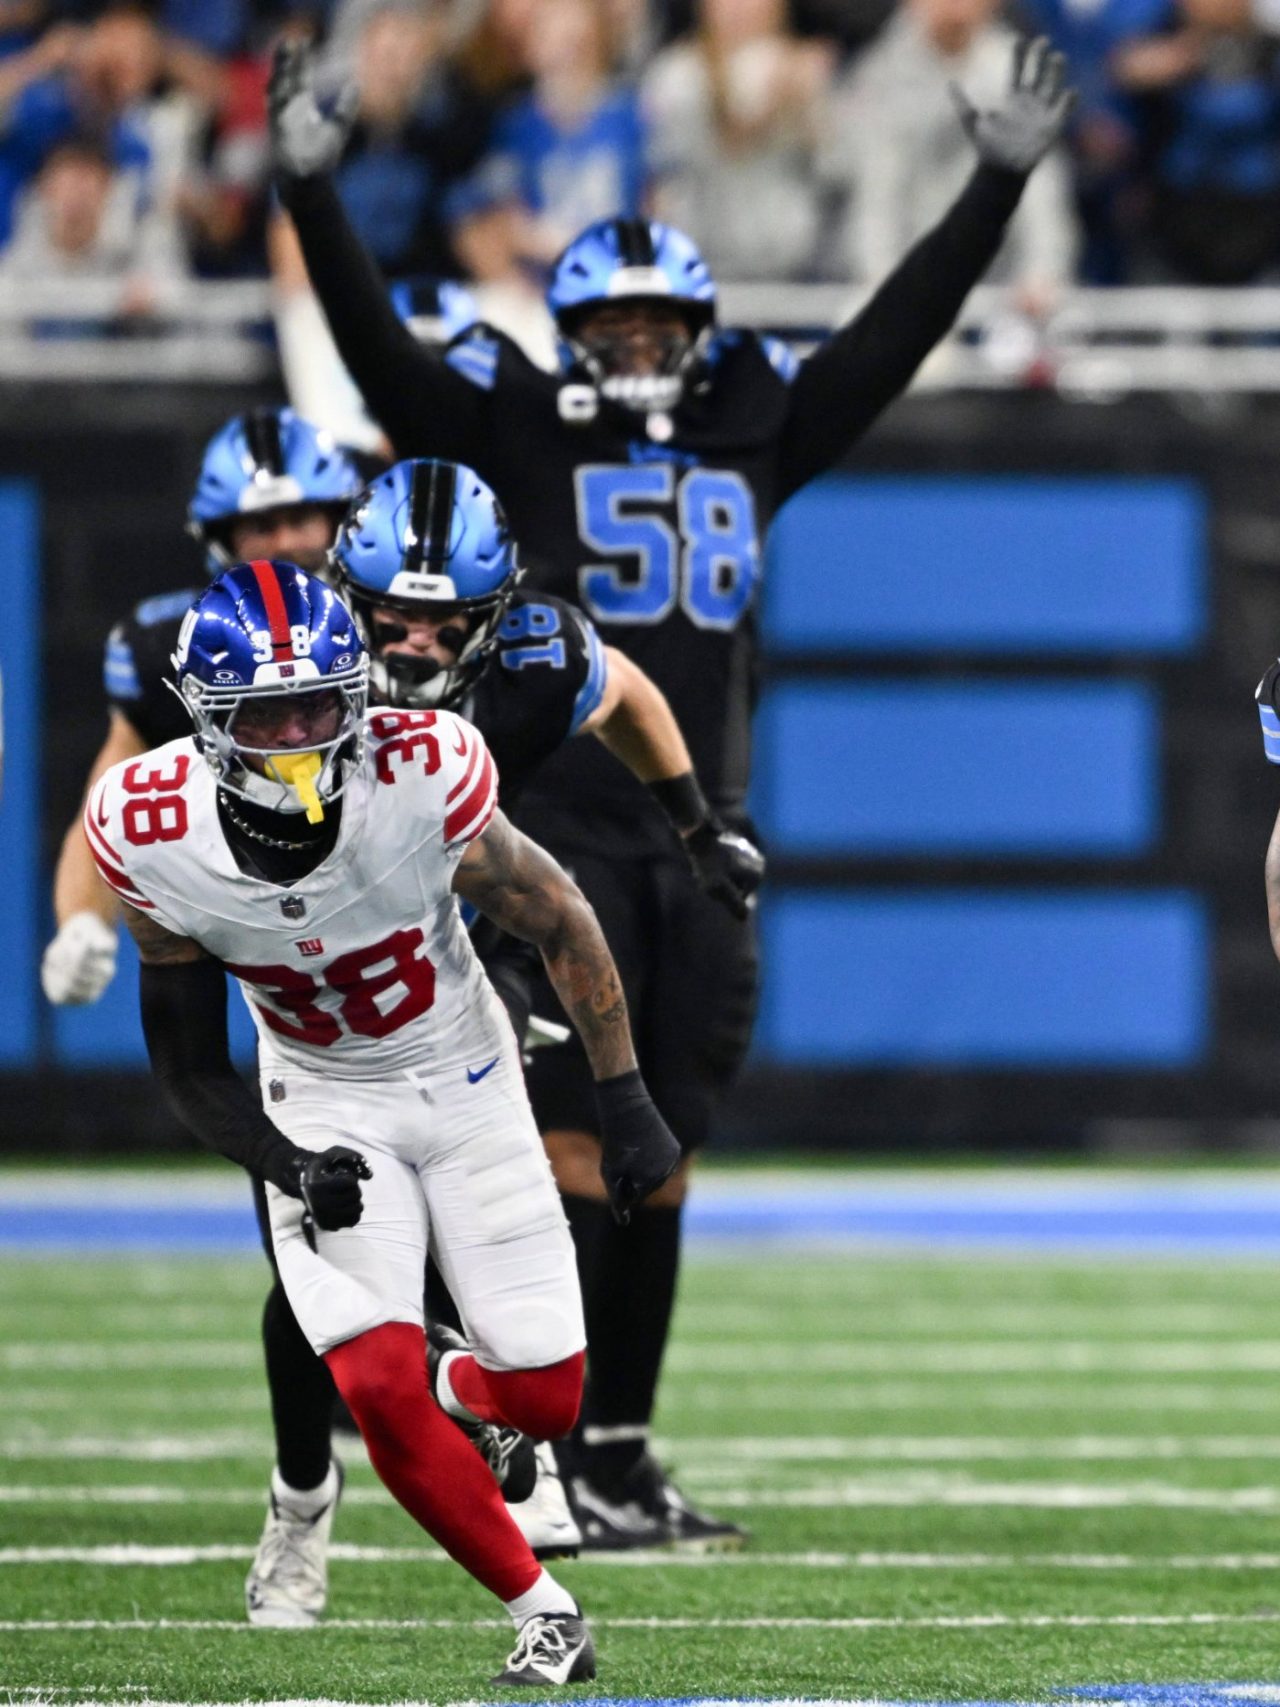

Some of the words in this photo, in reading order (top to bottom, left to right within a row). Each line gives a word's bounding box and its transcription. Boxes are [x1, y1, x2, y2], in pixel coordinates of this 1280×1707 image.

[573, 463, 759, 630] 58
[499, 602, 567, 671] 18
[370, 709, 442, 786] 38
[121, 754, 189, 847] 38
[224, 927, 437, 1047] 38
